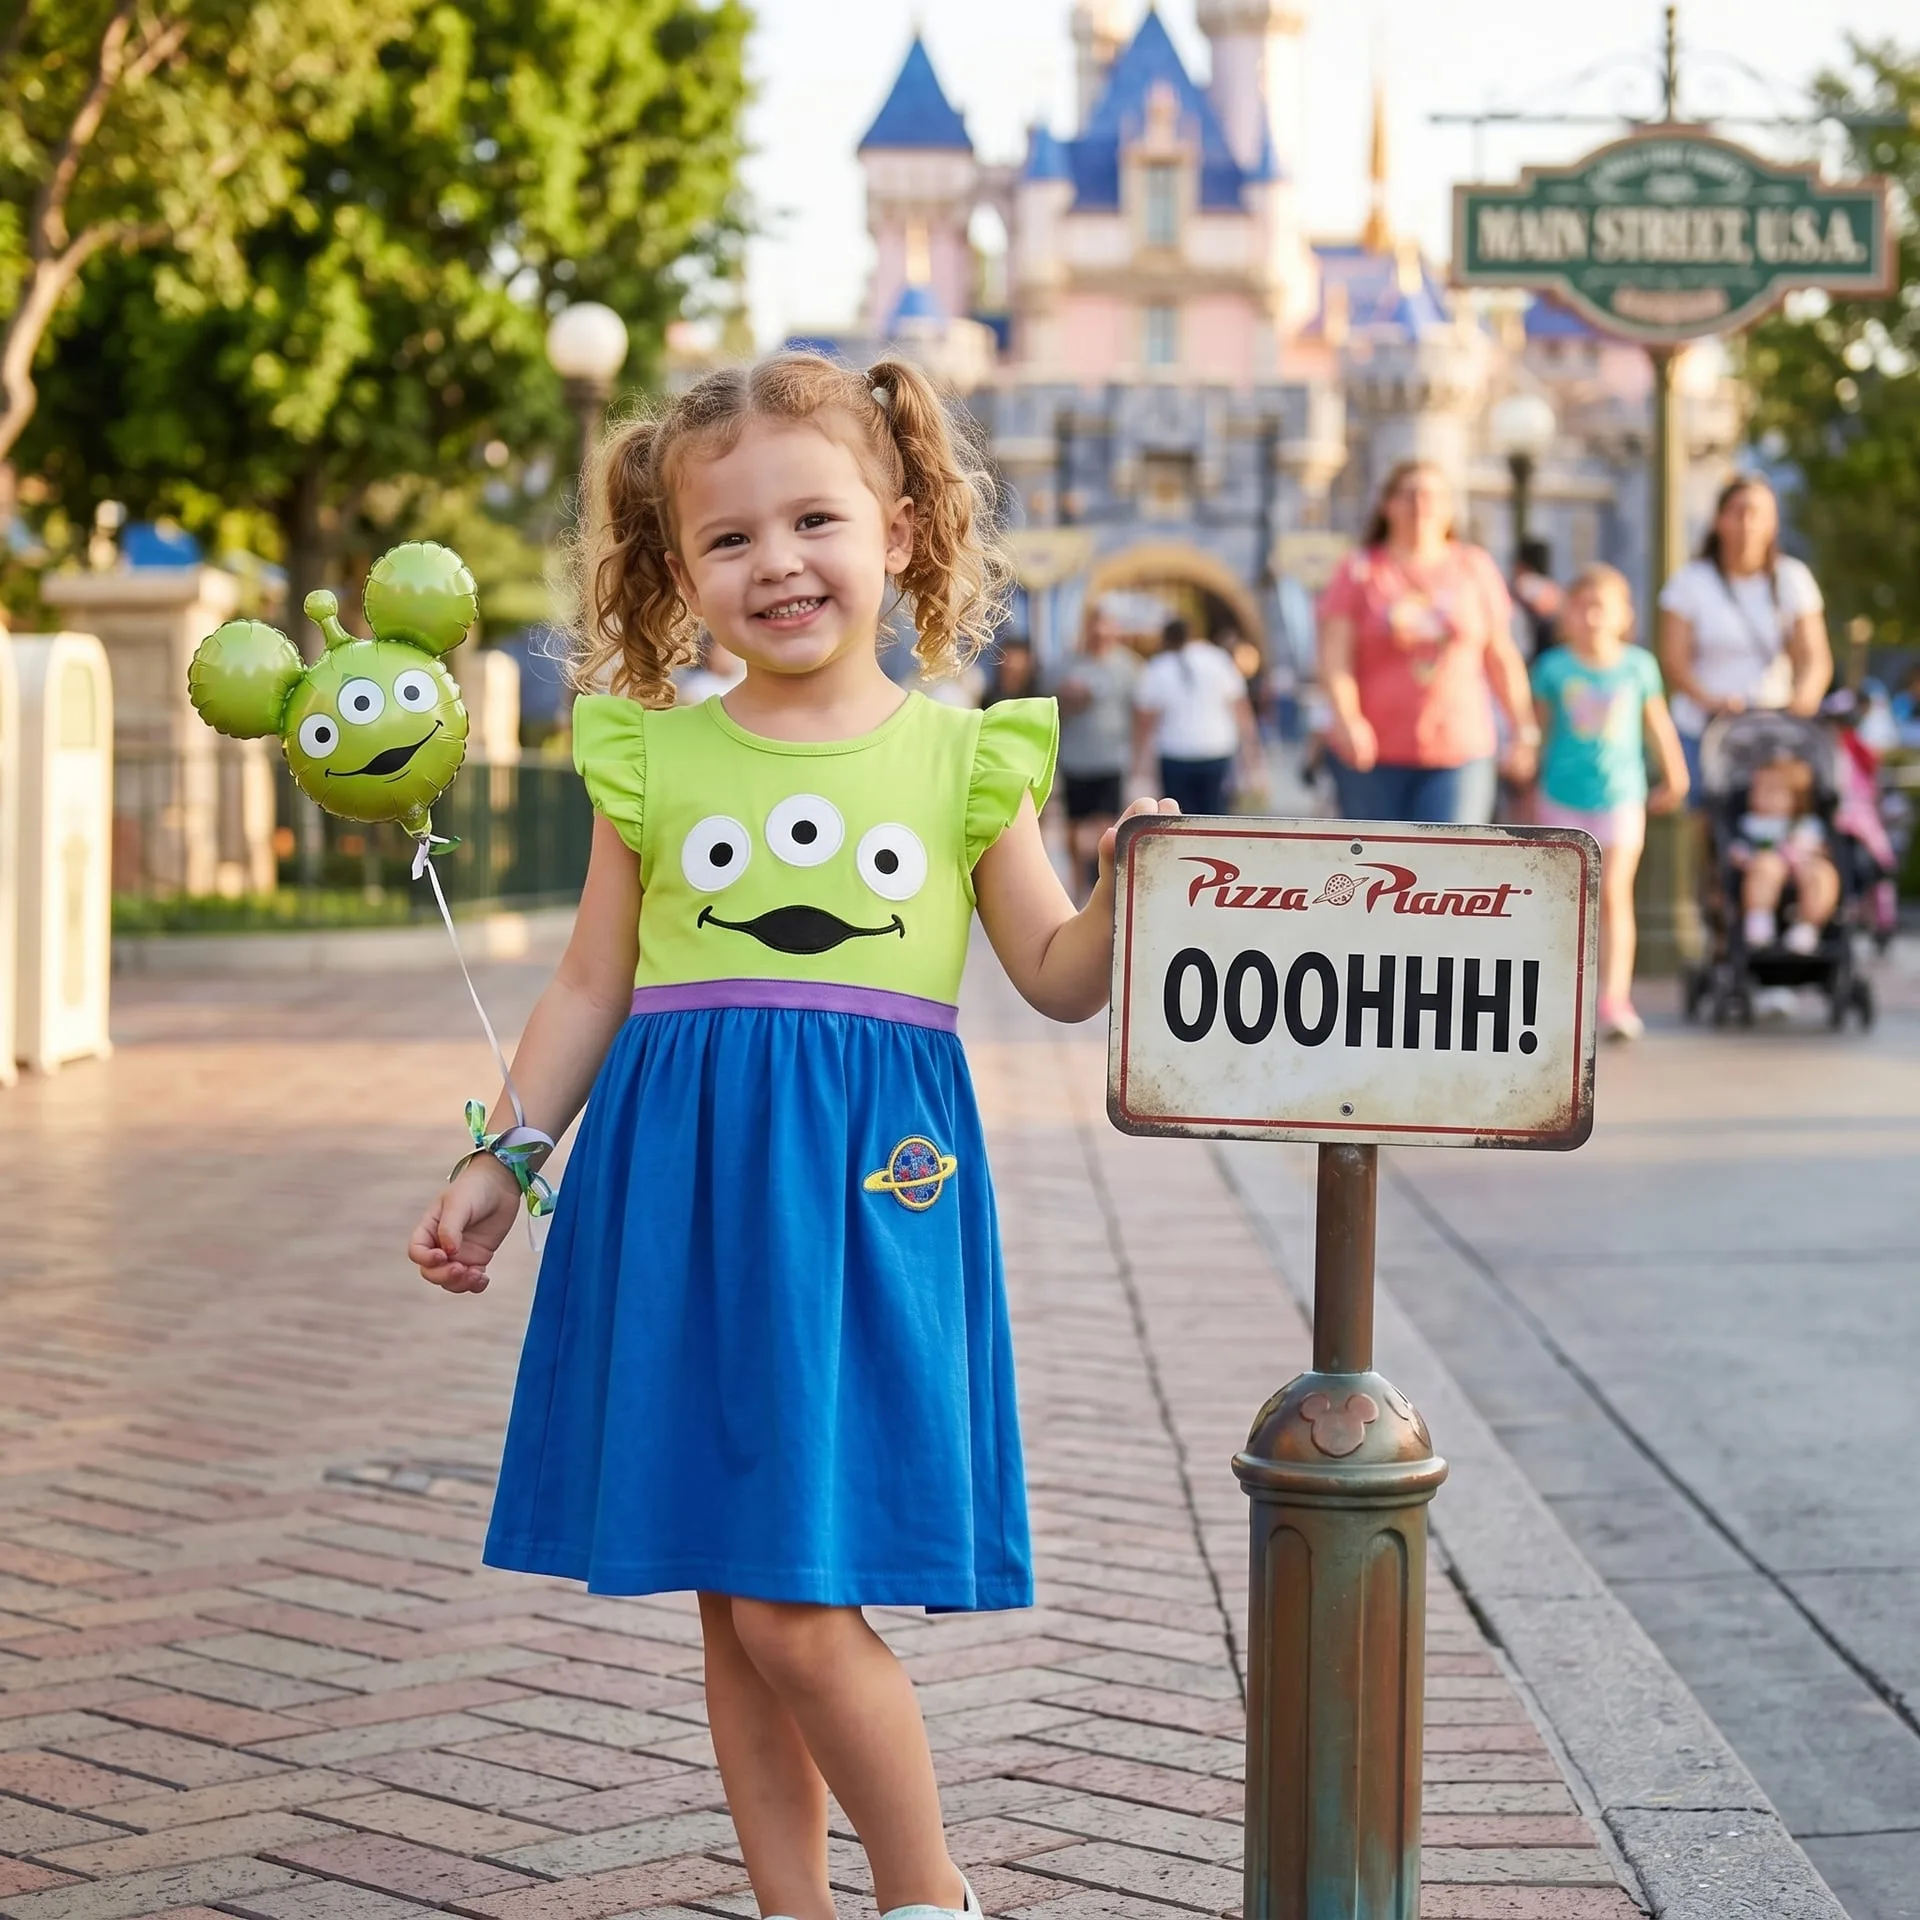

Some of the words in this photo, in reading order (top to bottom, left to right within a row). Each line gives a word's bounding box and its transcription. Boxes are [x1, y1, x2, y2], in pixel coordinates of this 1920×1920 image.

[1476, 206, 1588, 260] MAIN
[1178, 856, 1309, 911] Pizza
[1354, 862, 1533, 918] Planet
[1163, 947, 1540, 1055] OOOHHH!
